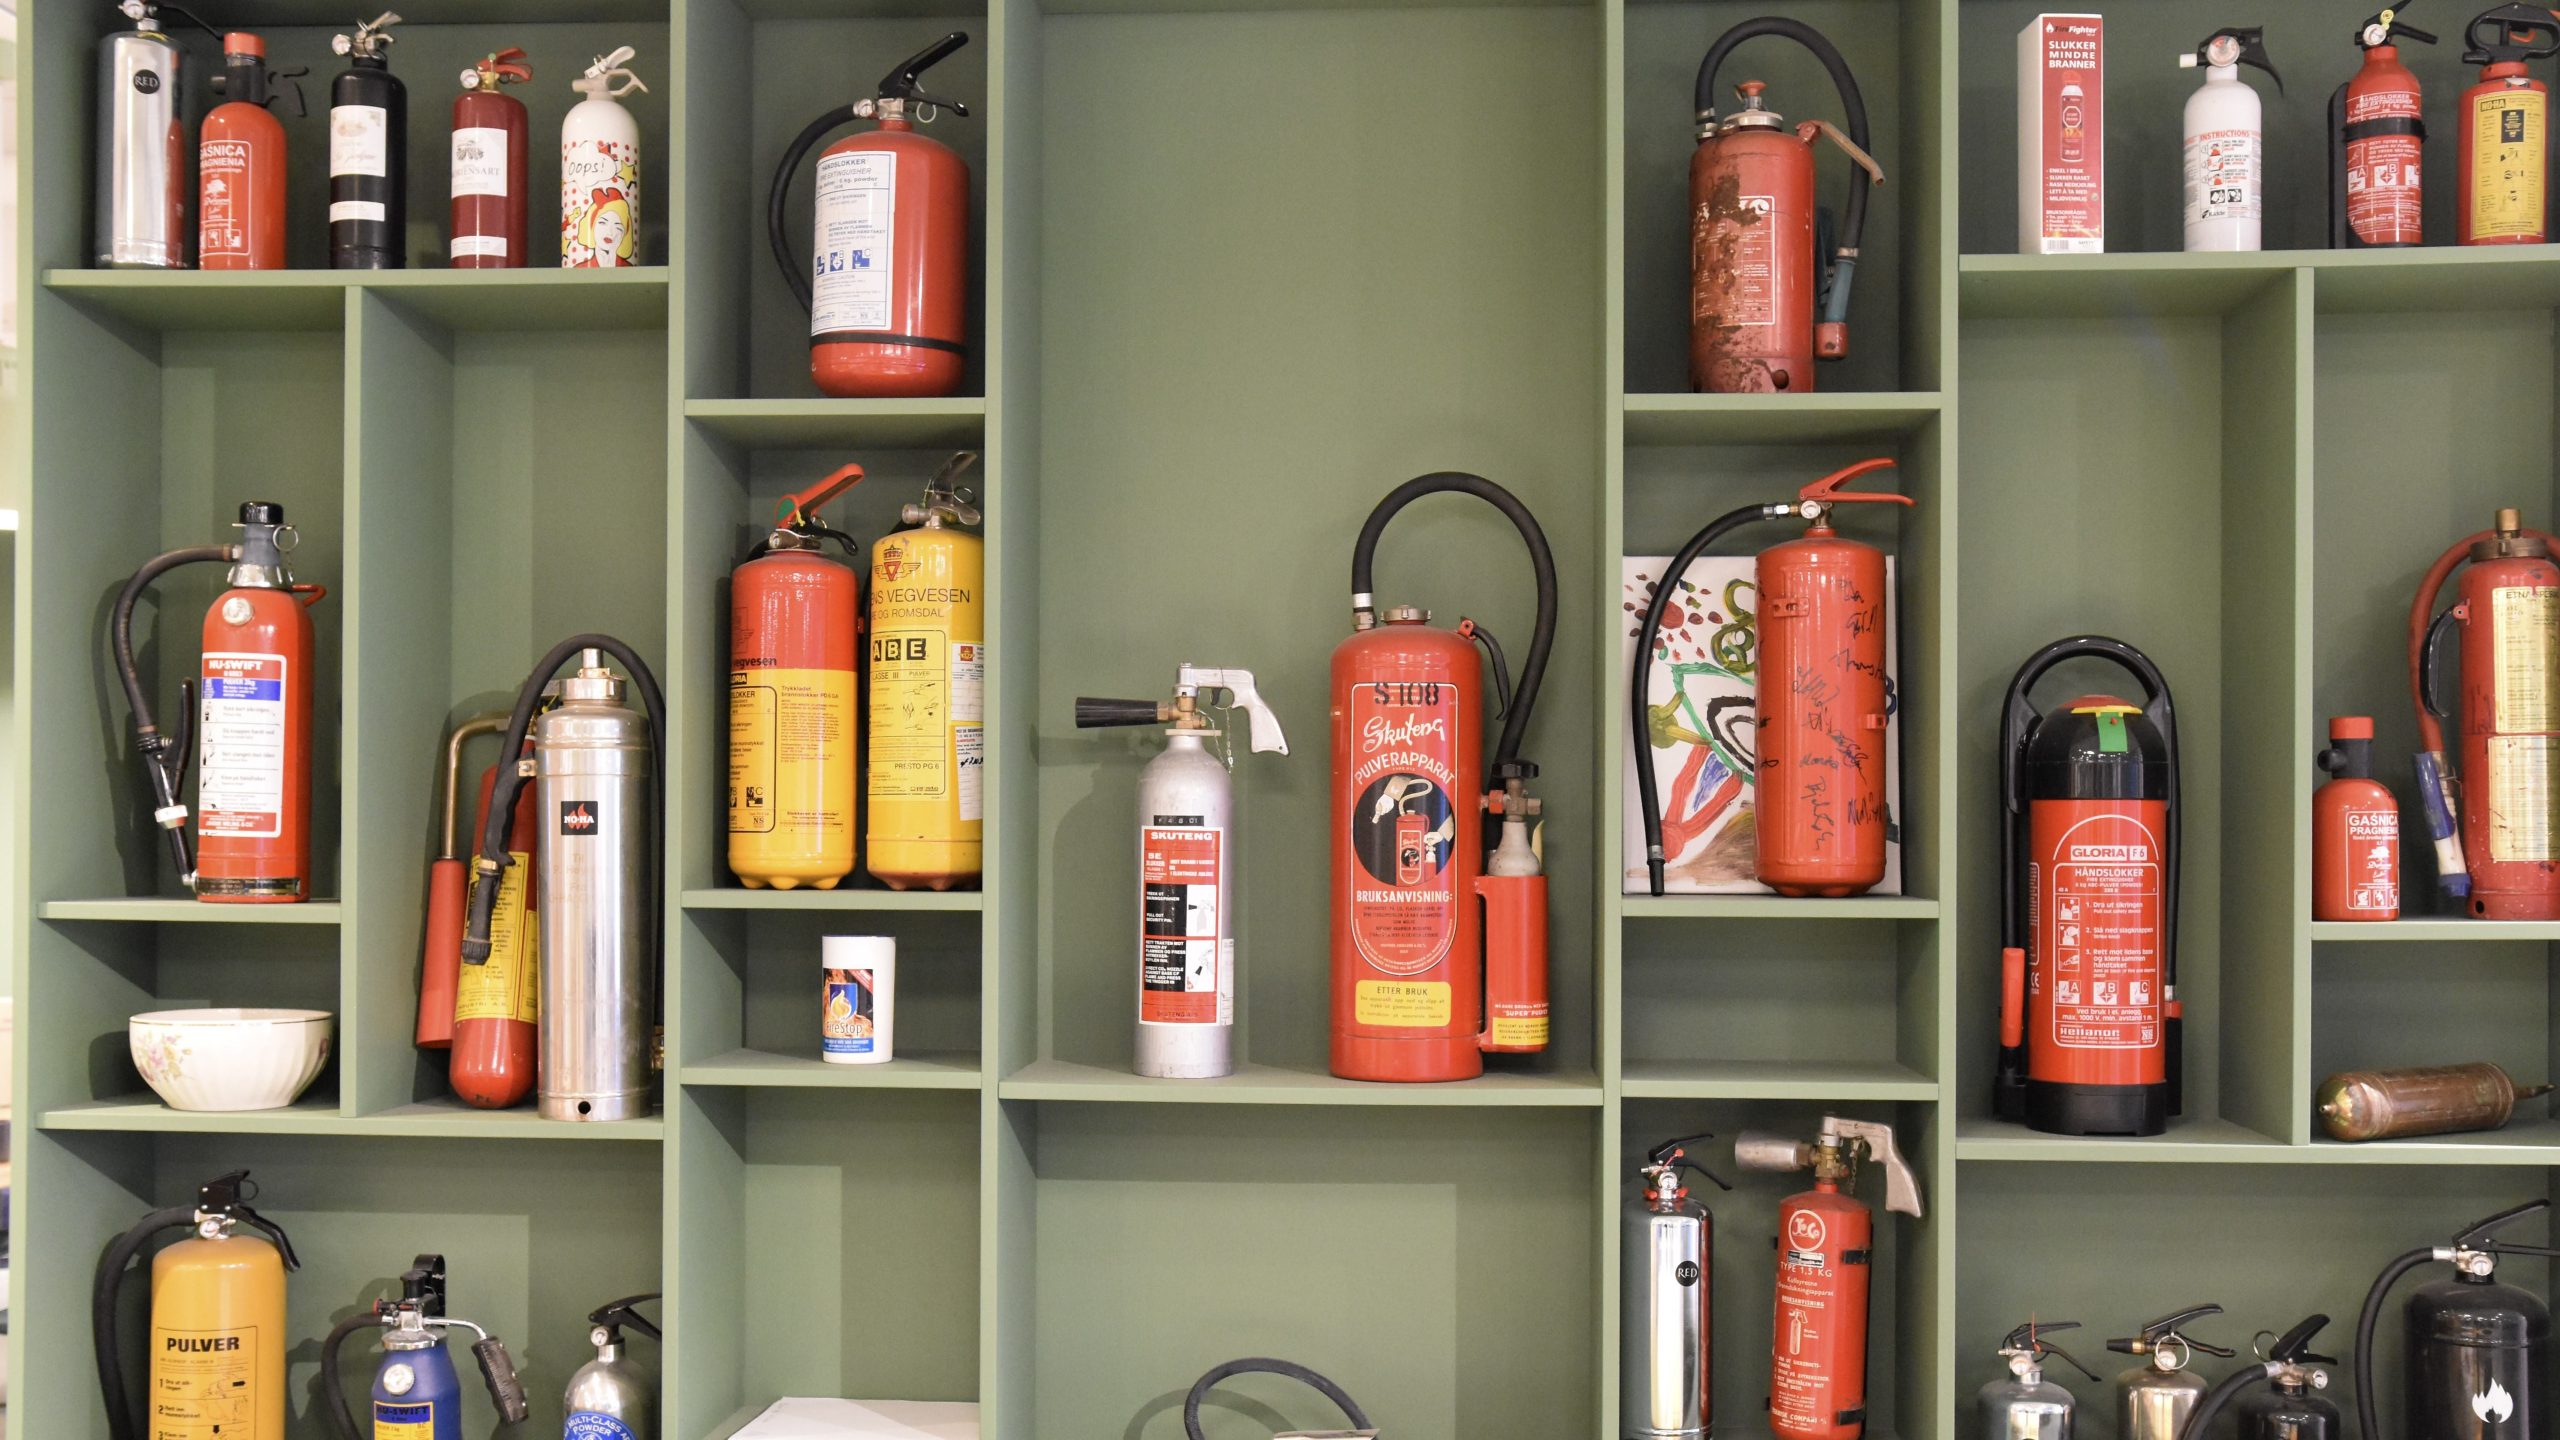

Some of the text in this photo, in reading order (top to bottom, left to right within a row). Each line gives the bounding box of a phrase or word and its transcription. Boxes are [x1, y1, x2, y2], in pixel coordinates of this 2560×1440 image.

[2049, 41, 2096, 50] SLUKKER
[2049, 51, 2096, 60] MINDRE
[2049, 60, 2096, 69] BRANNER
[134, 76, 159, 87] RED
[2200, 129, 2250, 140] INSTRUCTIONS
[568, 157, 606, 177] Oops!
[2389, 163, 2397, 173] B
[887, 588, 971, 604] VEGVESEN
[892, 607, 945, 618] ROMSDAL
[887, 640, 900, 659] B
[910, 640, 923, 657] E
[1363, 713, 1446, 753] Skuteng
[894, 762, 921, 770] PRESTO
[1354, 752, 1455, 785] PULVERAPPARAT
[755, 786, 763, 796] C
[1150, 831, 1213, 841] SKUTENG
[2071, 847, 2145, 858] GLORIA F 6
[1356, 890, 1453, 903] BRUKSANVISNING:
[1376, 986, 1428, 996] ETTER BRUK
[2070, 981, 2149, 993] A B C
[1677, 1267, 1698, 1278] RED
[1780, 1261, 1796, 1273] TYPE
[1817, 1269, 1833, 1278] KG
[166, 1336, 240, 1352] PULVER
[568, 1415, 622, 1433] MULTI-CLASS
[572, 1424, 612, 1436] POWDER
